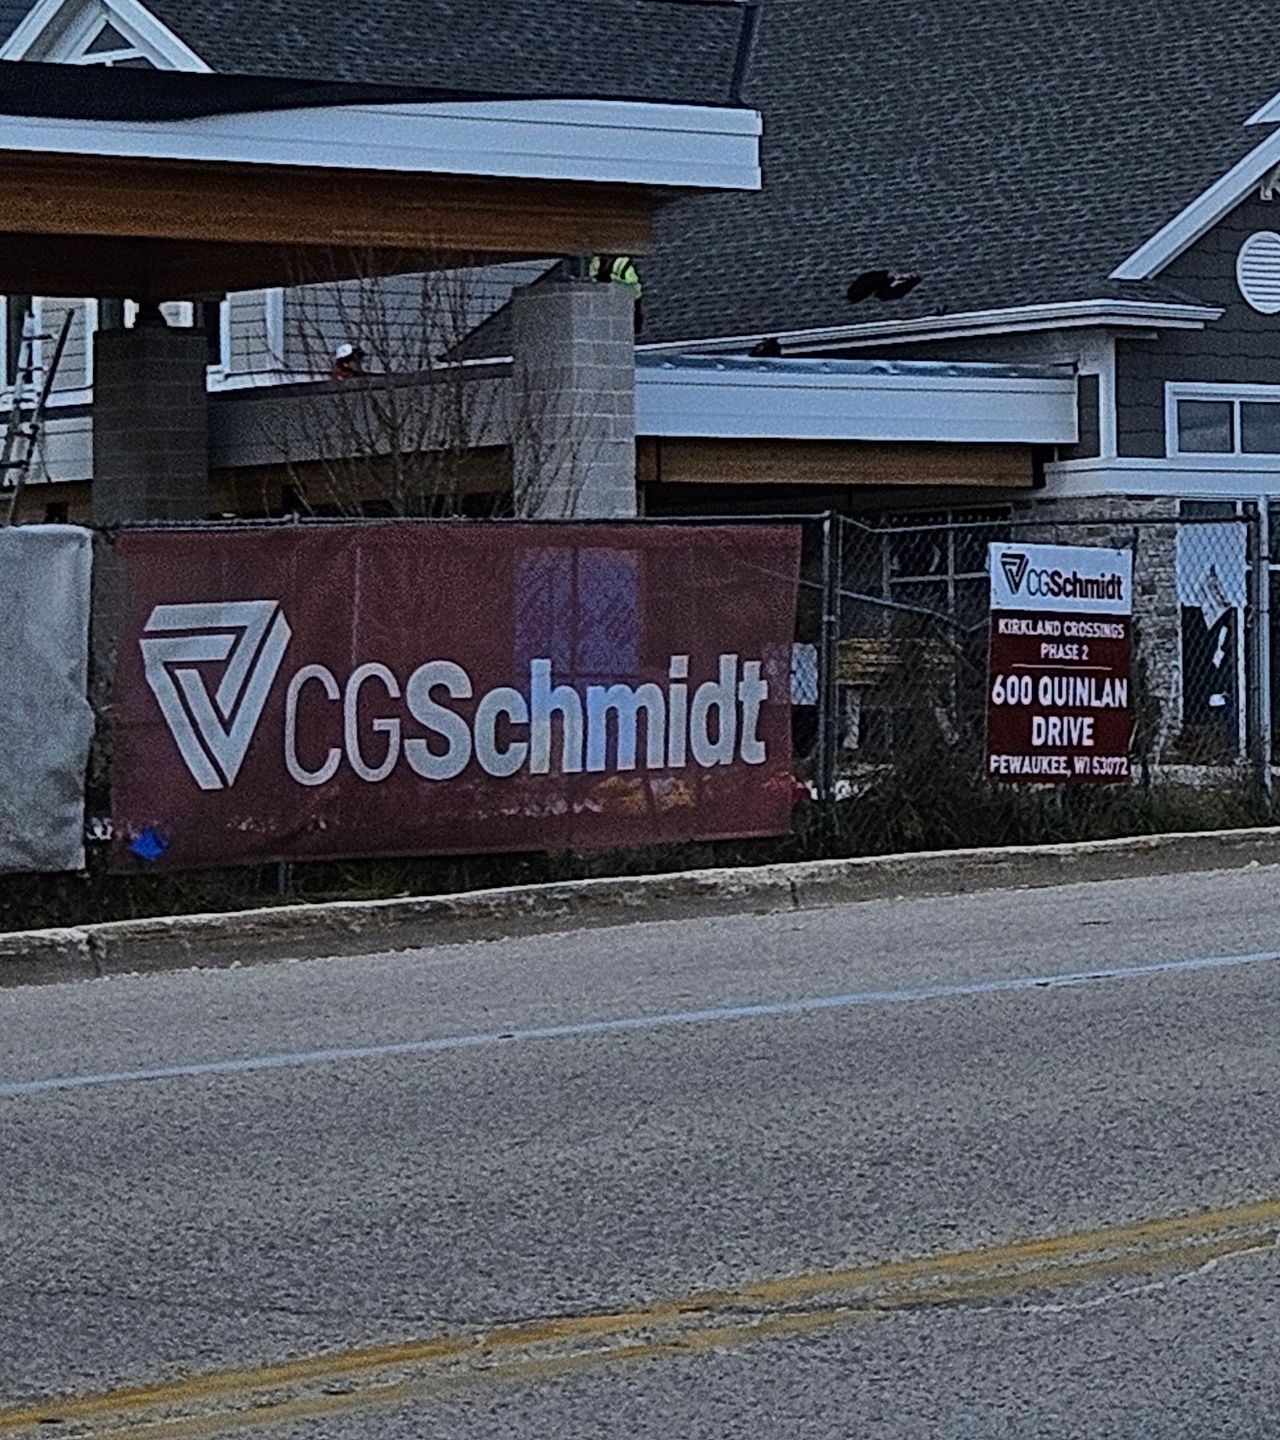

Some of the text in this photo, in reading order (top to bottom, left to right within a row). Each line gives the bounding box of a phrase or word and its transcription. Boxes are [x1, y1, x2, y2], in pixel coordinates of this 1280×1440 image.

[1027, 568, 1123, 600] CGSchmidt
[998, 618, 1125, 639] KIRKLAND CROSSINGS
[1040, 642, 1089, 660] PHASE 2
[991, 674, 1128, 708] 600 QUINLAN
[285, 654, 767, 786] CGSchmidt
[1031, 715, 1095, 747] DRIVE
[989, 754, 1129, 778] PEWAUKEE, WI 53072
